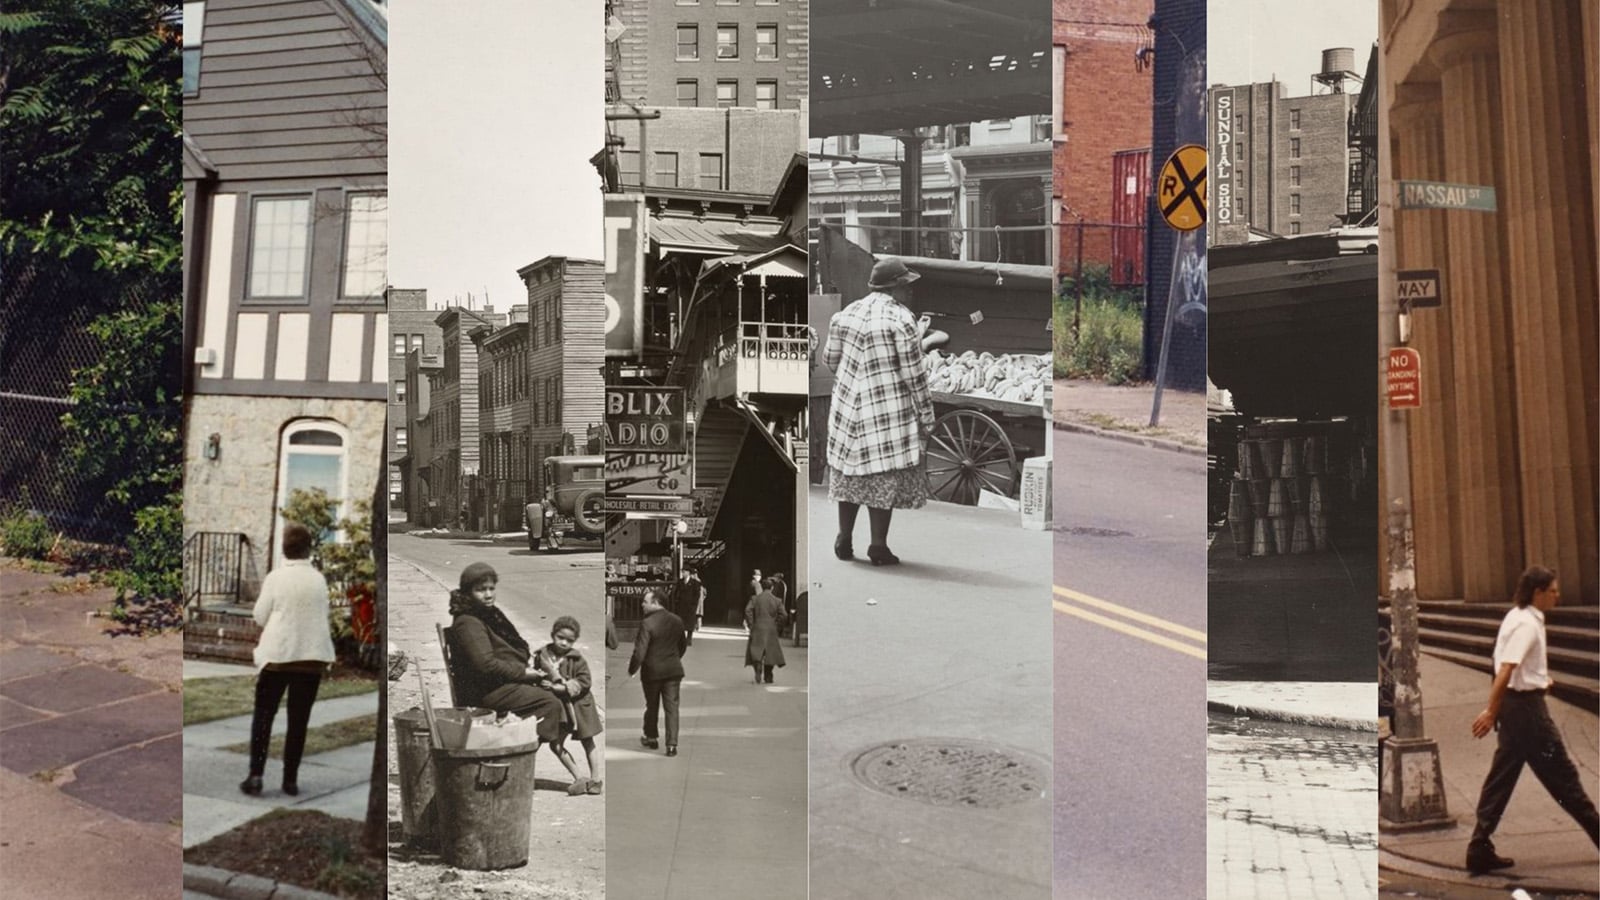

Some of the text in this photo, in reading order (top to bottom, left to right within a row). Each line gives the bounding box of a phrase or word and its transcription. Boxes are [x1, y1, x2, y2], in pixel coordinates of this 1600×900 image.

[1217, 96, 1231, 223] SUNDIAL SHO
[1163, 176, 1177, 197] R
[1404, 183, 1481, 206] NASSAU ST
[1391, 355, 1409, 368] NO
[608, 392, 672, 415] BLIX
